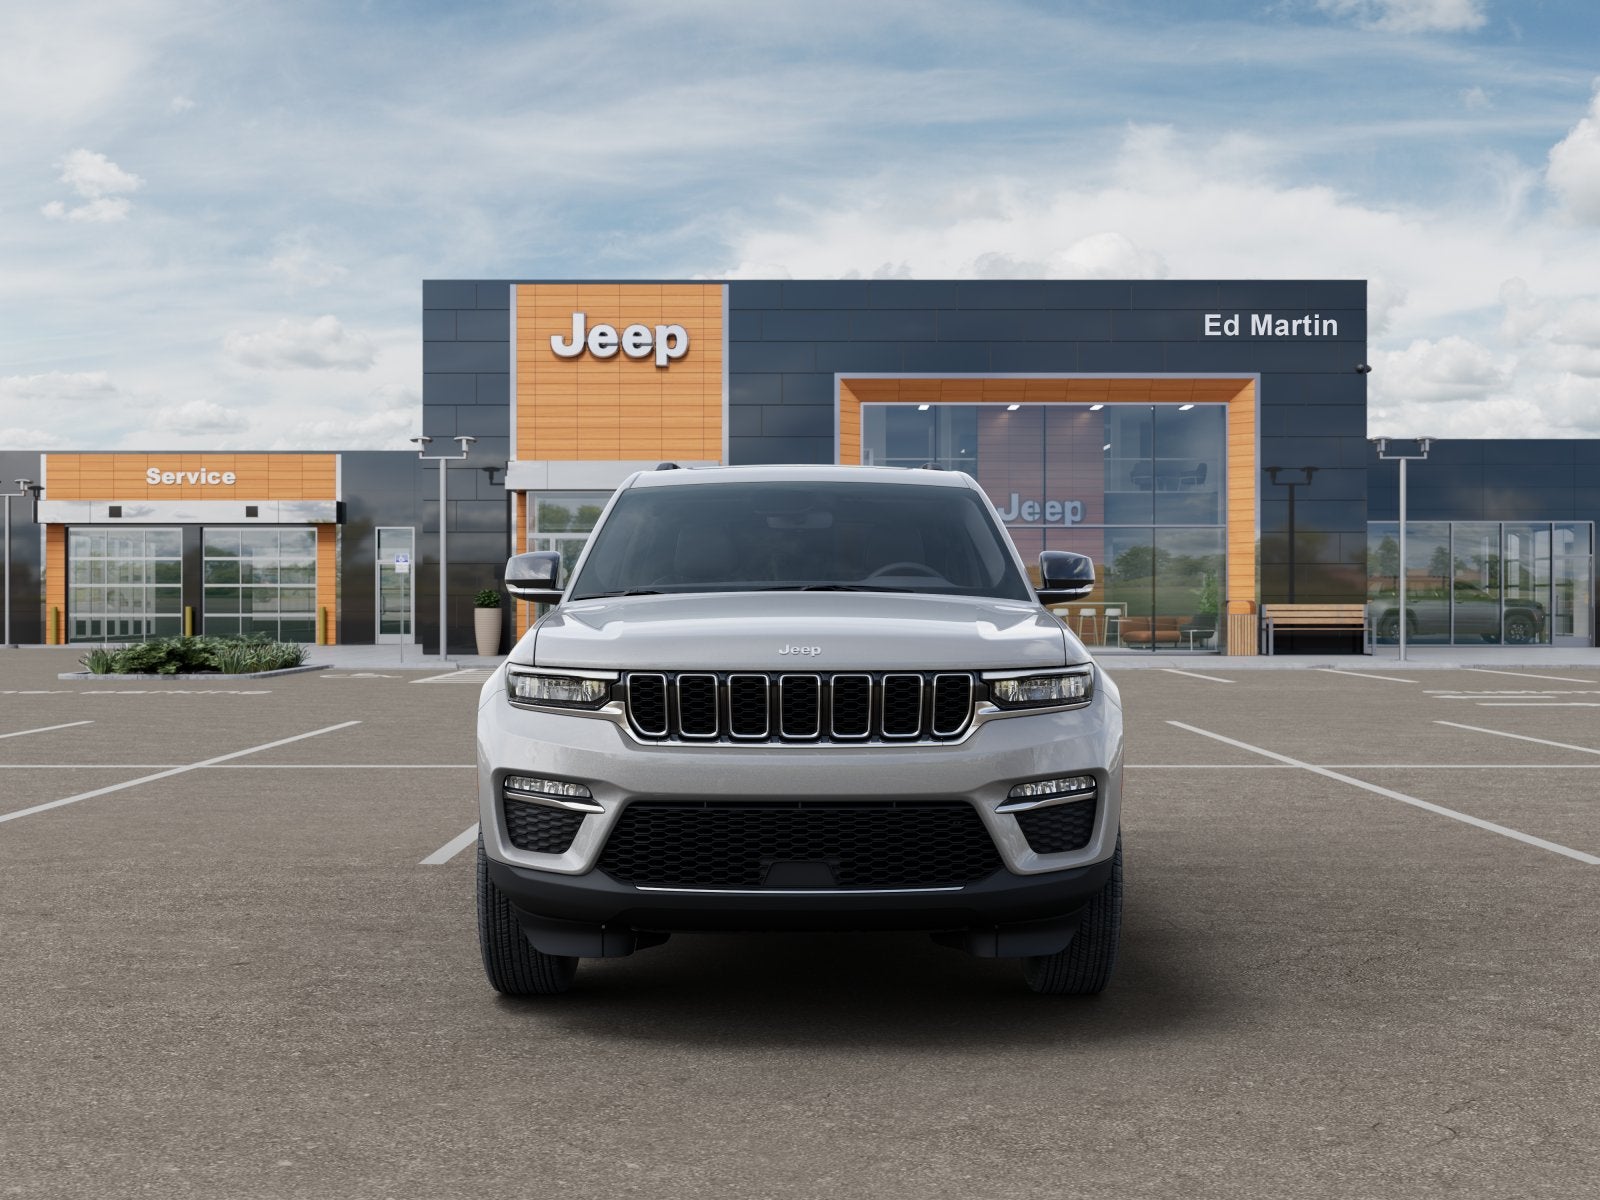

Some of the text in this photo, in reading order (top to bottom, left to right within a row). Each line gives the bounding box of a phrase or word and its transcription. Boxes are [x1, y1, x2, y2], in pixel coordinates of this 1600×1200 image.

[1204, 314, 1338, 336] Ed Martin
[550, 312, 689, 367] Jeep
[146, 467, 236, 485] Service
[997, 493, 1084, 526] Jeep
[778, 644, 822, 657] Jeep
